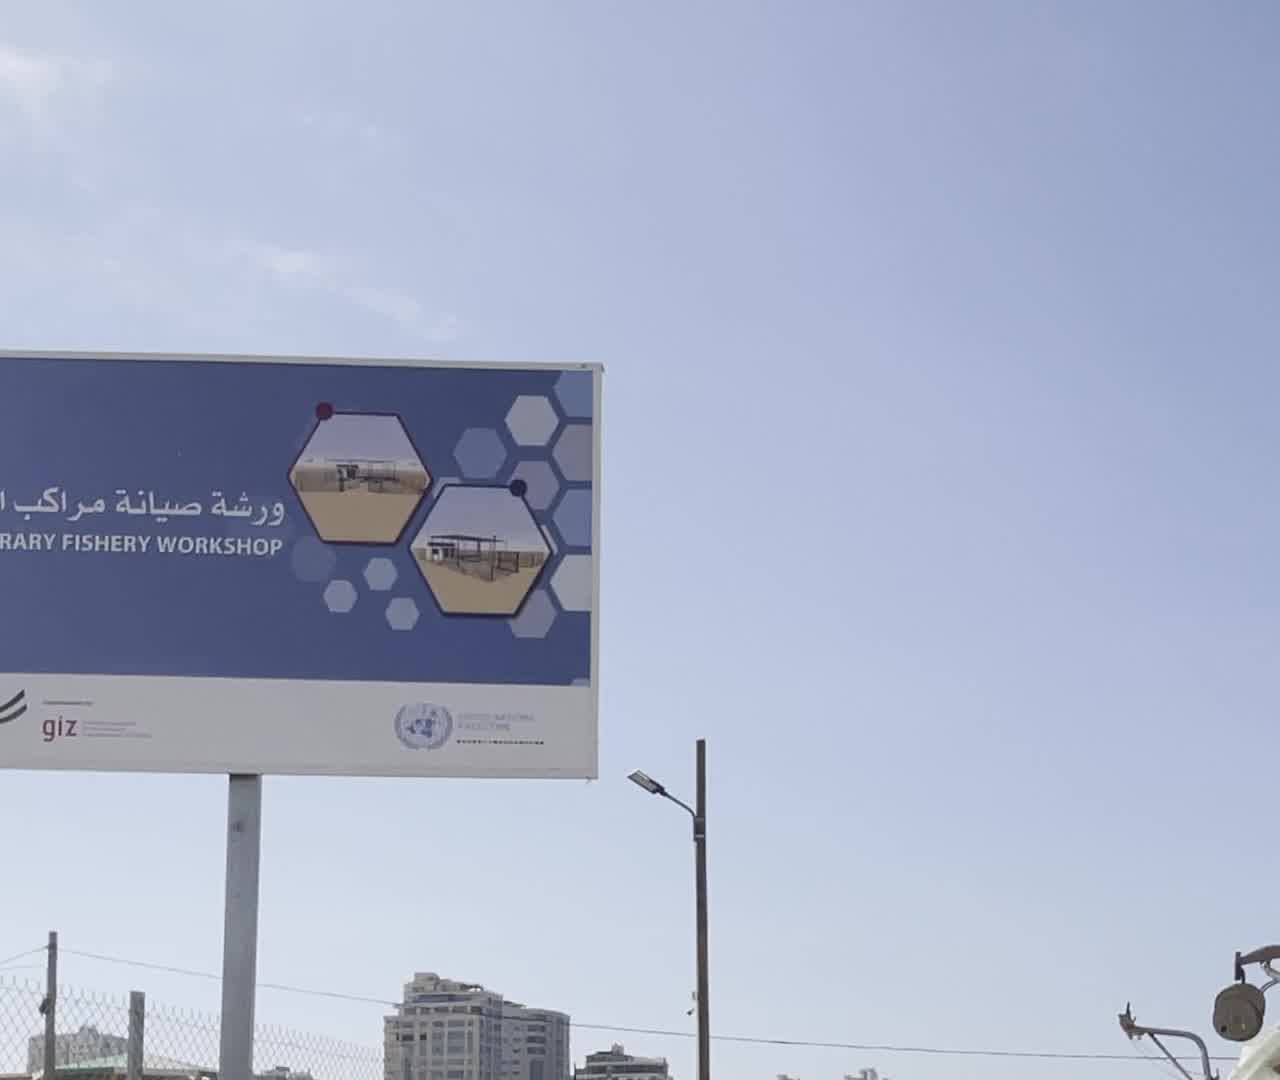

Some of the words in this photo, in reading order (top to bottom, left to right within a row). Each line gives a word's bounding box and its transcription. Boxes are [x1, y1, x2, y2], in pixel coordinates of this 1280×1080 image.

[13, 486, 105, 521] مراكب
[115, 489, 202, 523] صيانة
[211, 491, 285, 526] ورشة
[62, 534, 151, 553] FISHERY
[157, 535, 283, 556] WORKSHOP
[42, 715, 78, 742] giz
